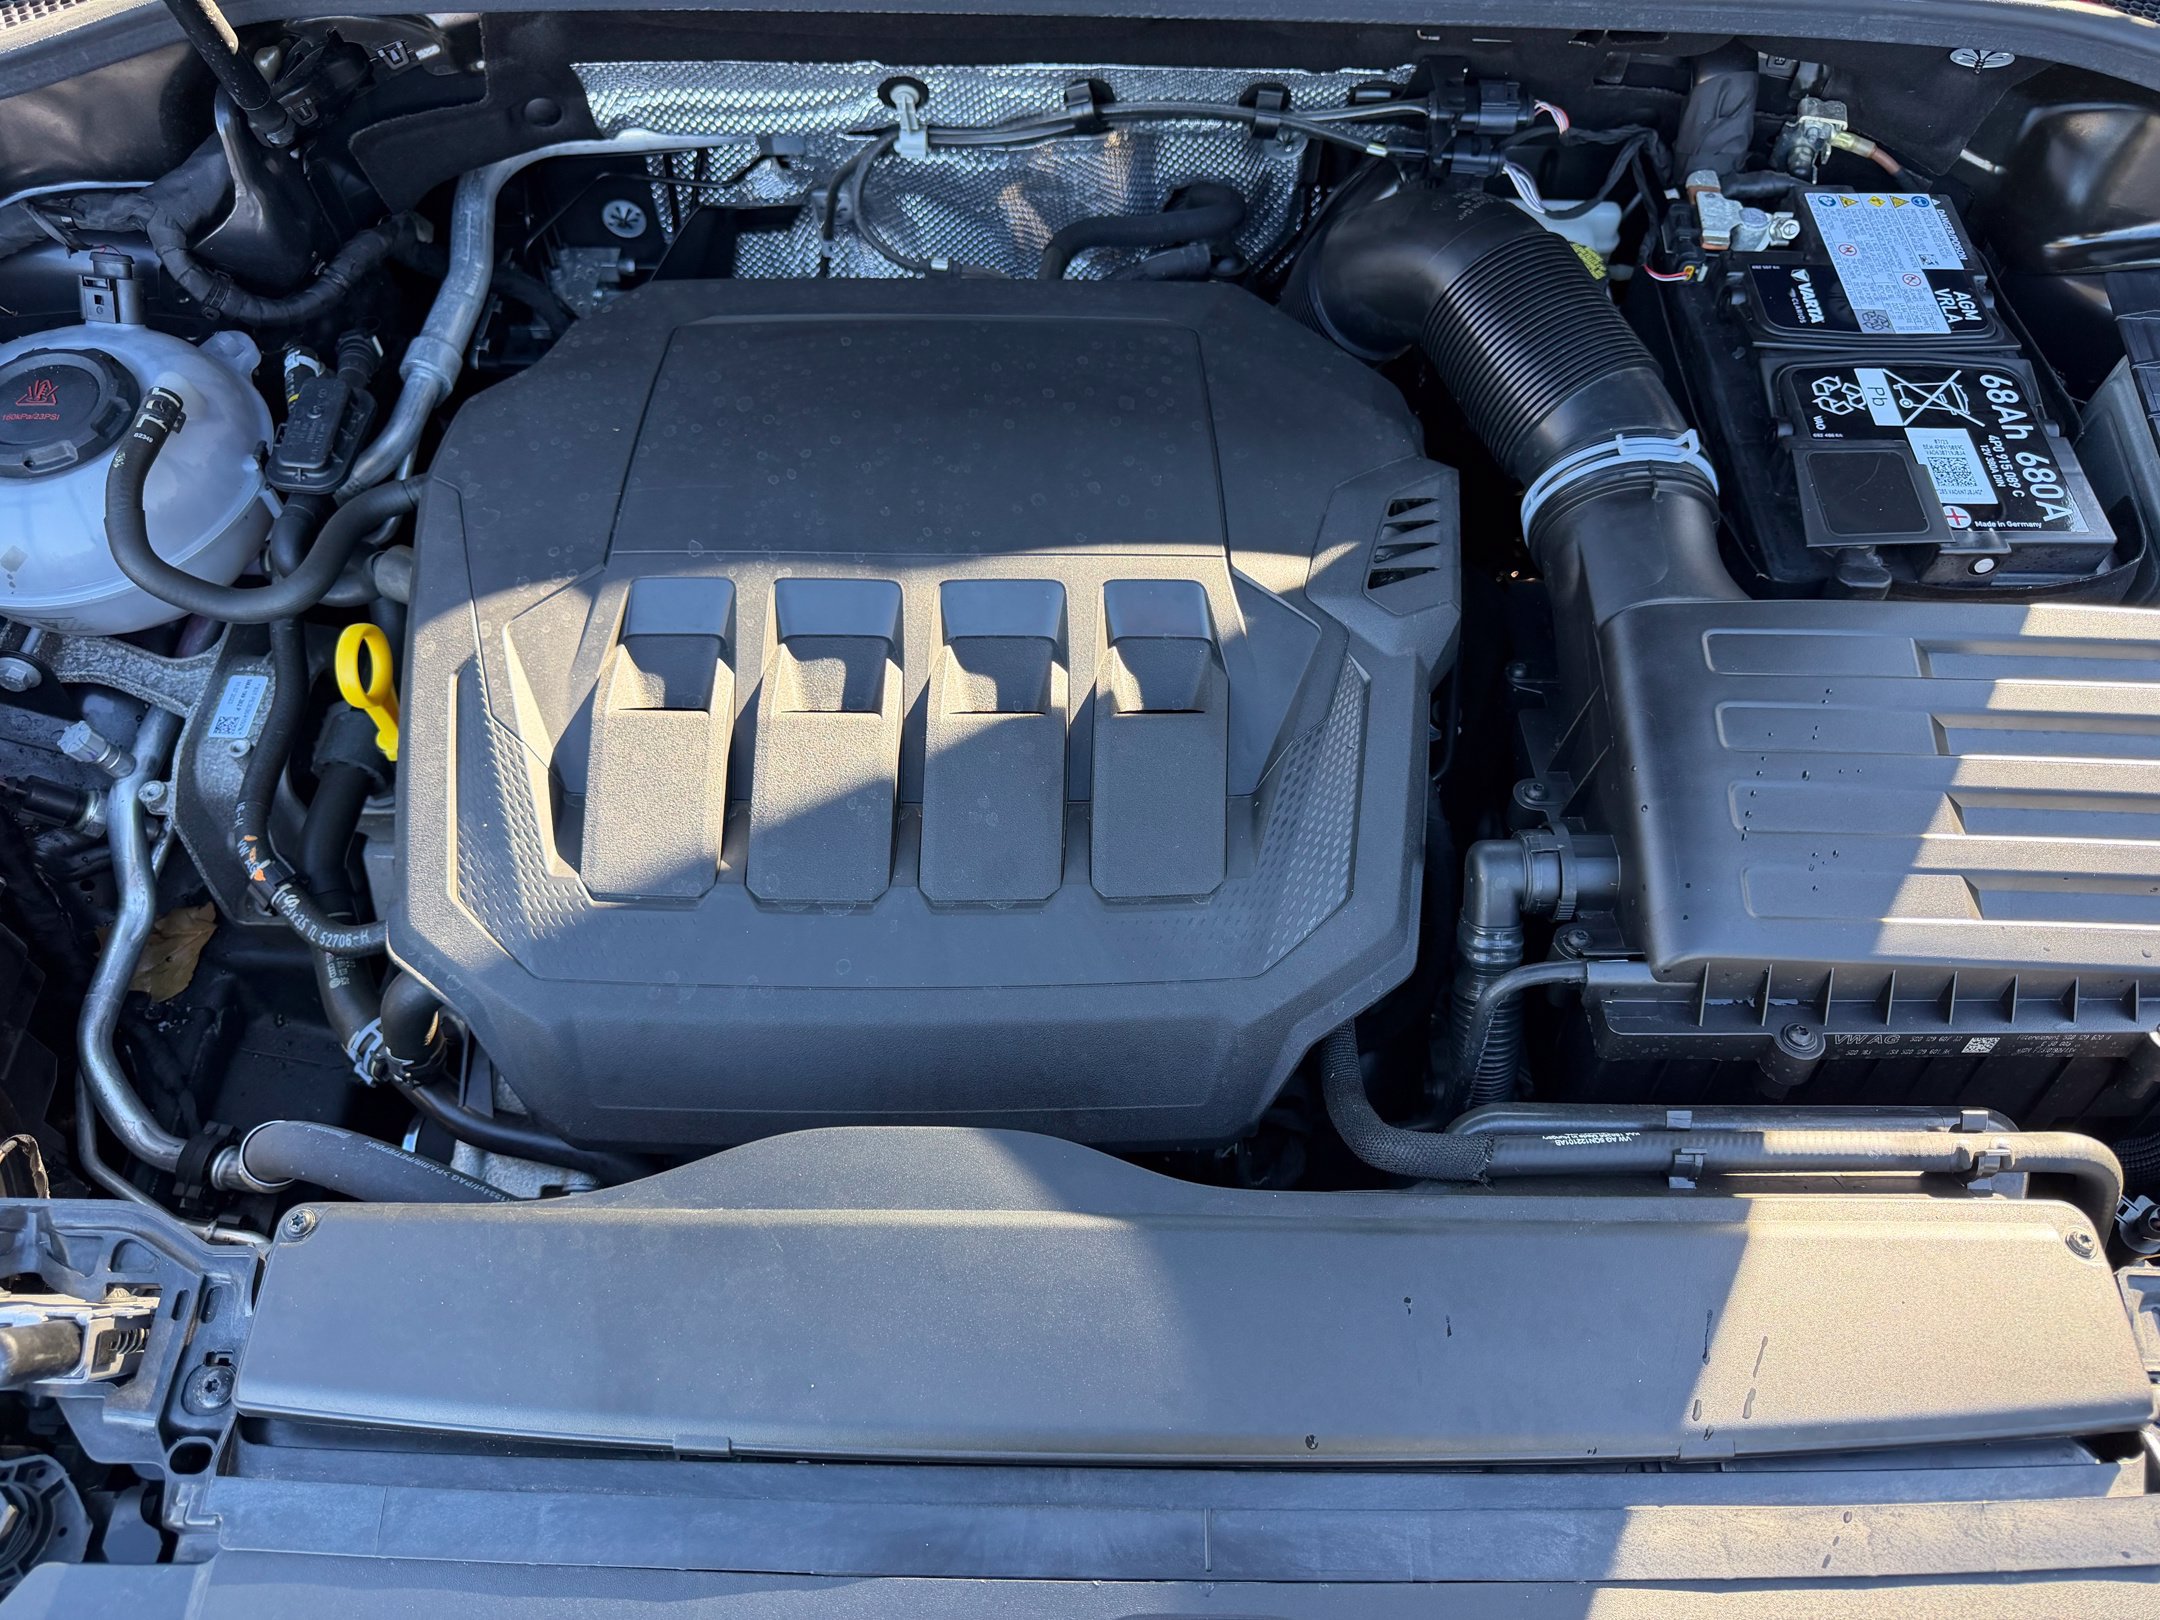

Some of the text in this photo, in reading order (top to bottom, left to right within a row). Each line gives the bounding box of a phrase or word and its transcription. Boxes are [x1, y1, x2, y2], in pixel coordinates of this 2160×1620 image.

[1936, 208, 1968, 261] DANGER/POISON
[1791, 297, 1807, 324] CLARIOS
[1797, 282, 1825, 324] VARTA
[1934, 287, 1963, 324] VRLA
[1952, 290, 1982, 321] AGM
[1866, 386, 1888, 407] Pb
[1979, 374, 2074, 522] 68Ah 680A
[1979, 444, 1993, 459] 12V
[1992, 474, 2006, 488] DIN
[1996, 453, 2013, 471] 915
[2004, 471, 2021, 489] 089
[2012, 489, 2025, 498] C
[2006, 521, 2042, 529] Germany
[1834, 1034, 1869, 1045] VW
[1867, 1034, 1900, 1044] AG
